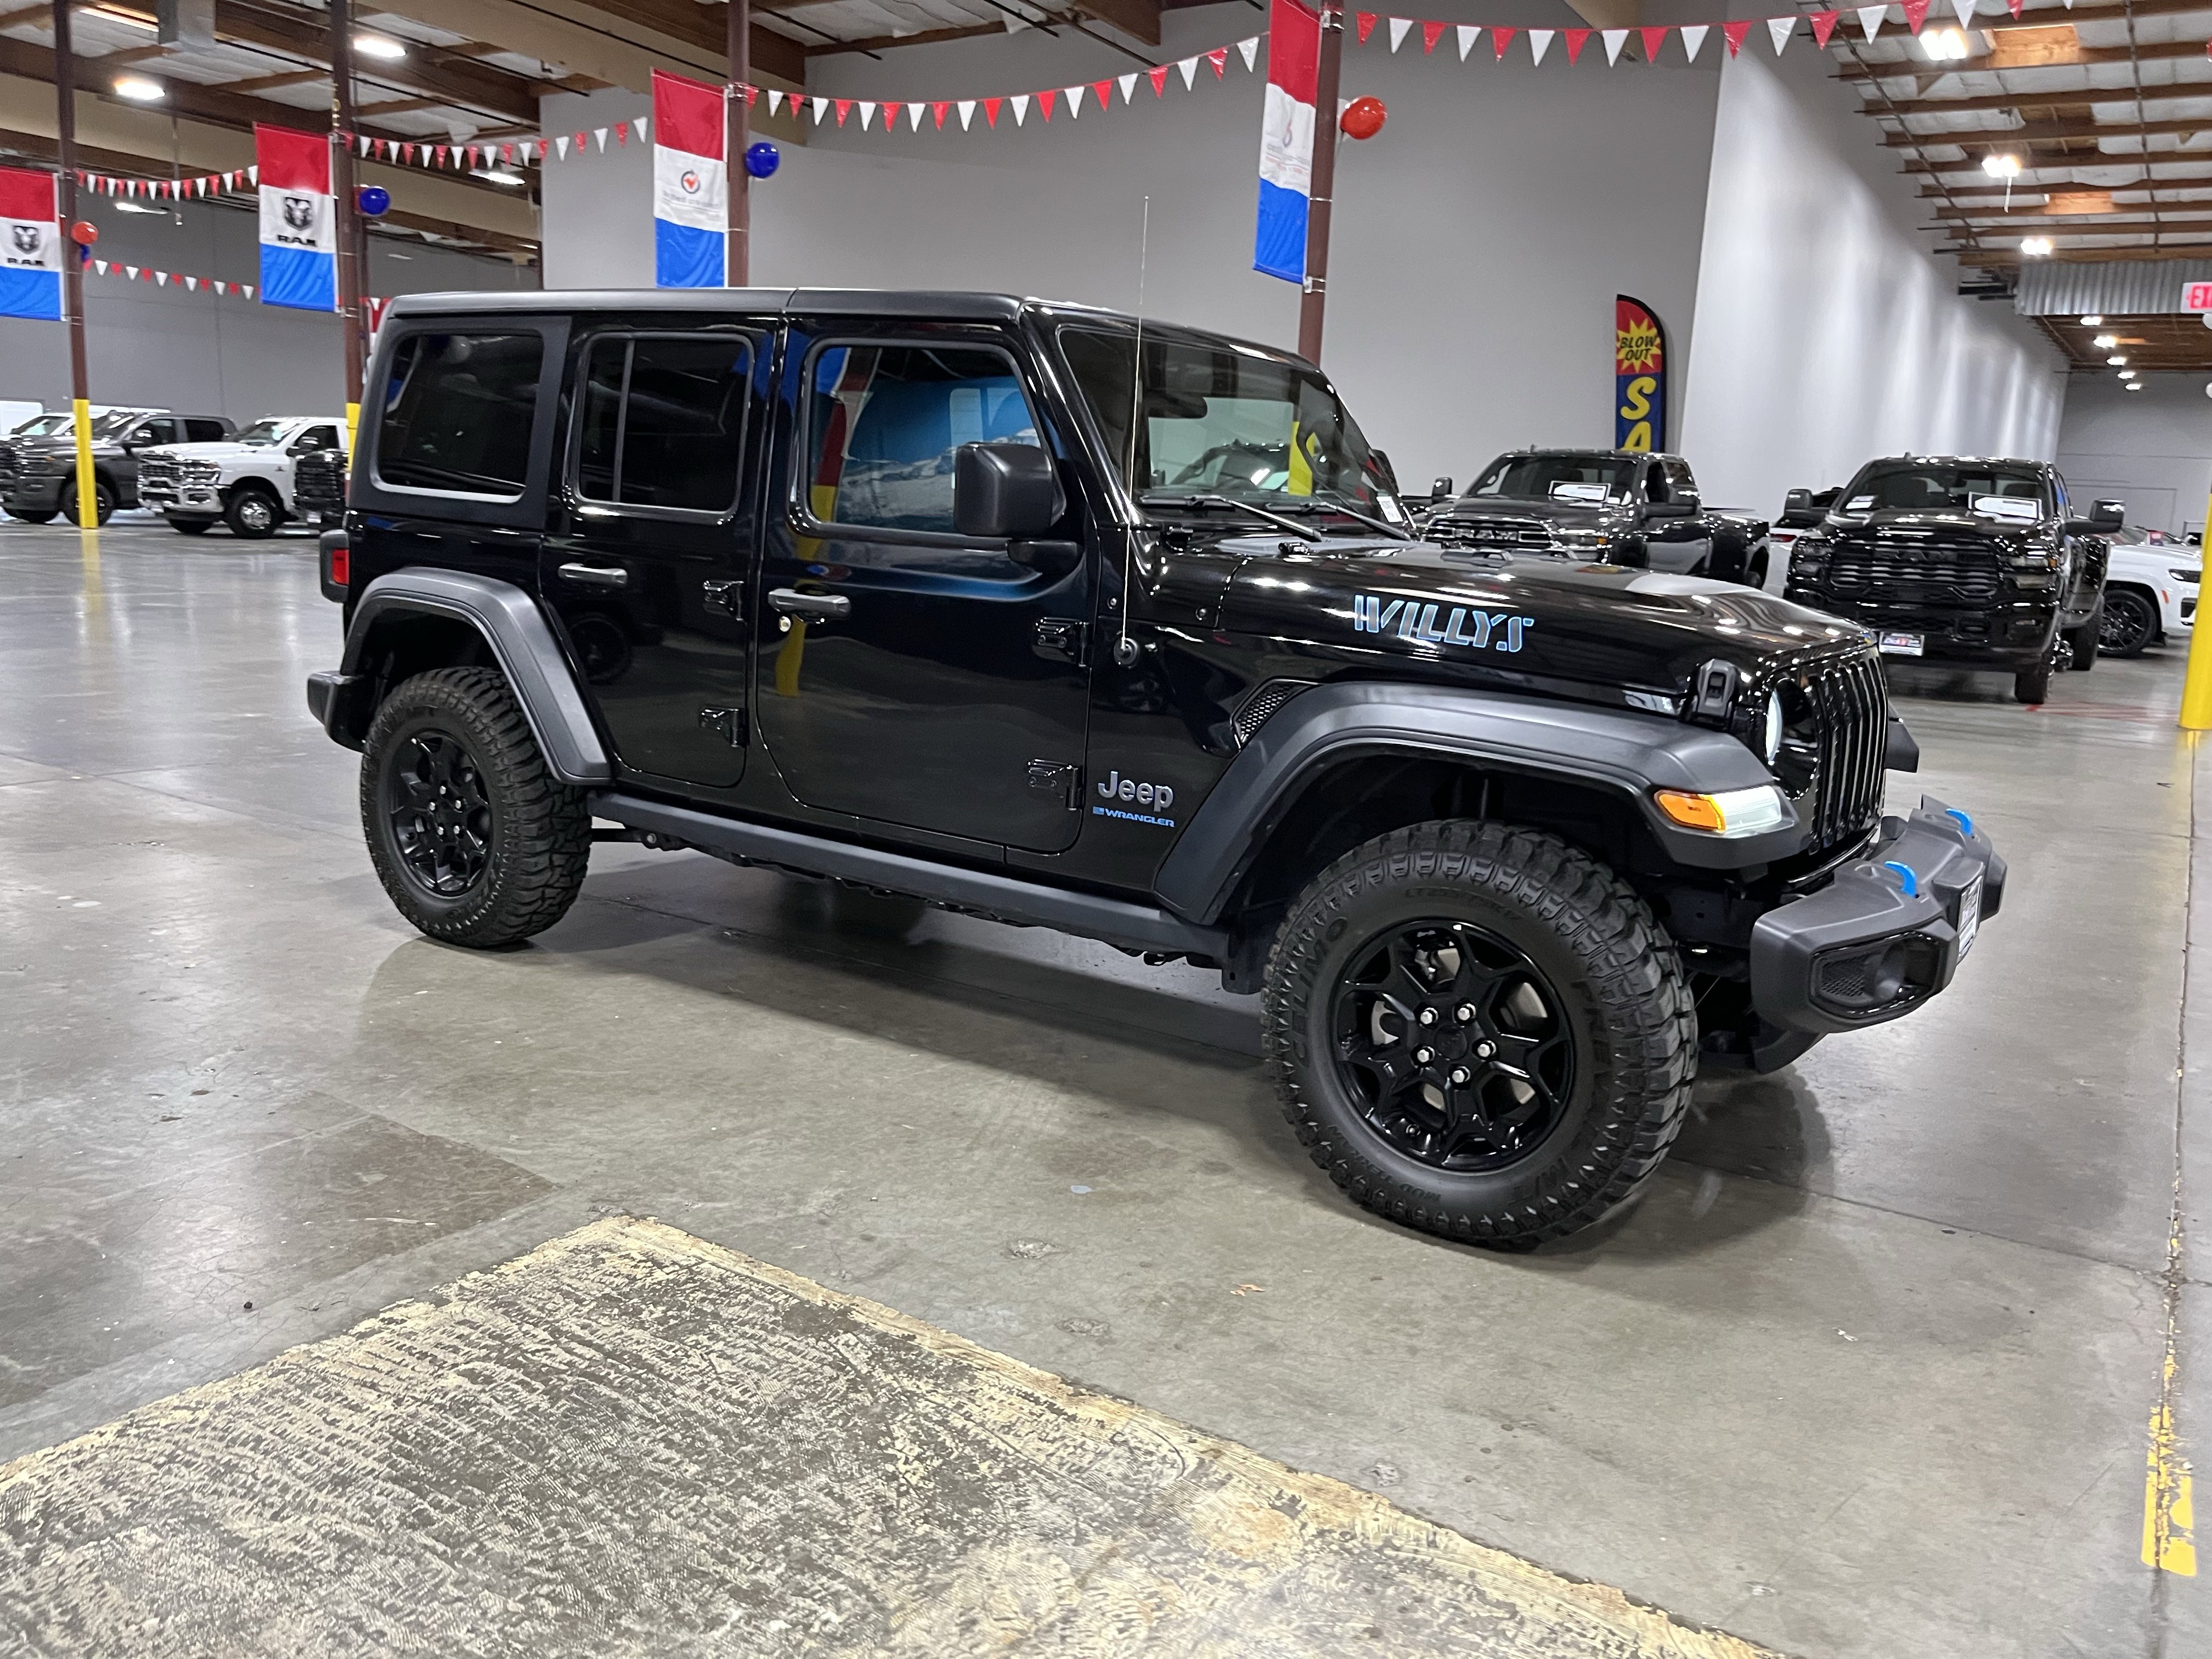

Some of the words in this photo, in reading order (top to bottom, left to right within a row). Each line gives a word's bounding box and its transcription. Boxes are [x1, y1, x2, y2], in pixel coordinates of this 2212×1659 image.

[277, 234, 317, 247] RAM
[7, 257, 45, 267] RAM
[1620, 336, 1656, 348] BLOW
[1625, 348, 1651, 361] OUT
[1354, 594, 1534, 652] WILLYS
[1098, 771, 1173, 812] Jeep
[1105, 808, 1175, 827] WRANGLER
